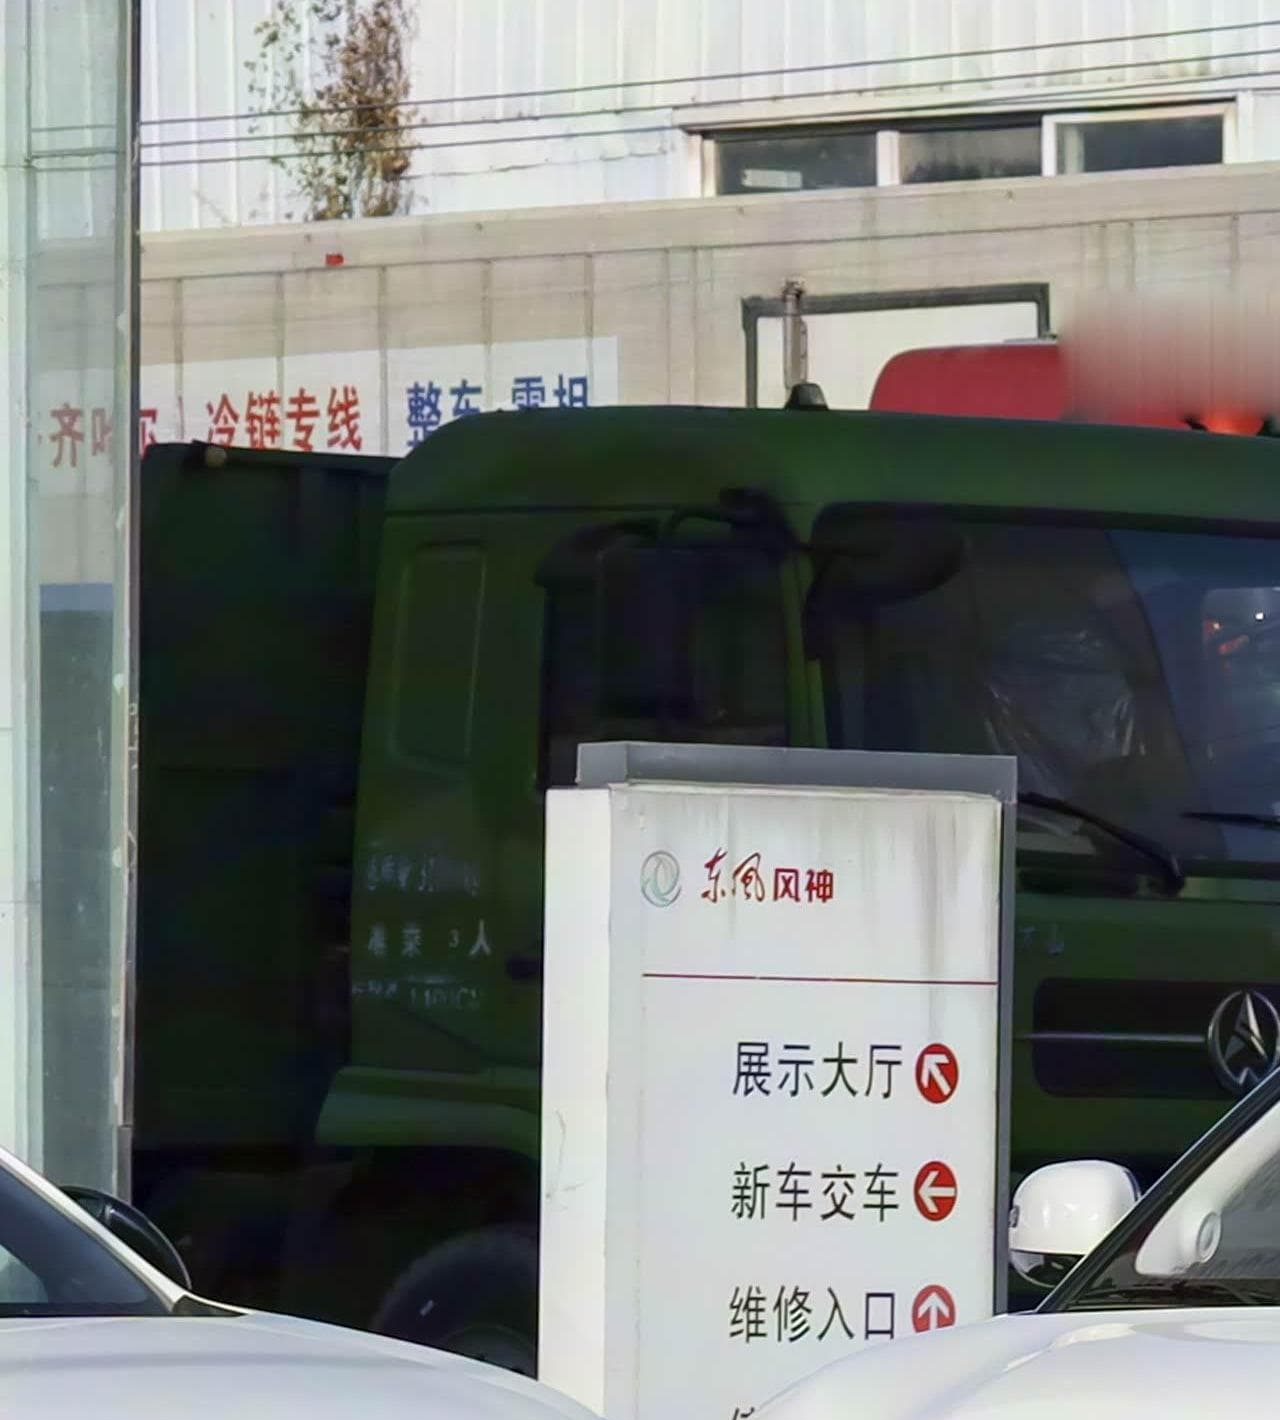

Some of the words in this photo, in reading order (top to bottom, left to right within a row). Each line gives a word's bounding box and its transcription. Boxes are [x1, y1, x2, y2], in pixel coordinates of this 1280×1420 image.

[206, 385, 363, 452] 冷链专线
[732, 1041, 902, 1099] 展示大厅
[731, 1161, 900, 1222] 新车交车
[728, 1284, 896, 1343] 维修入口
